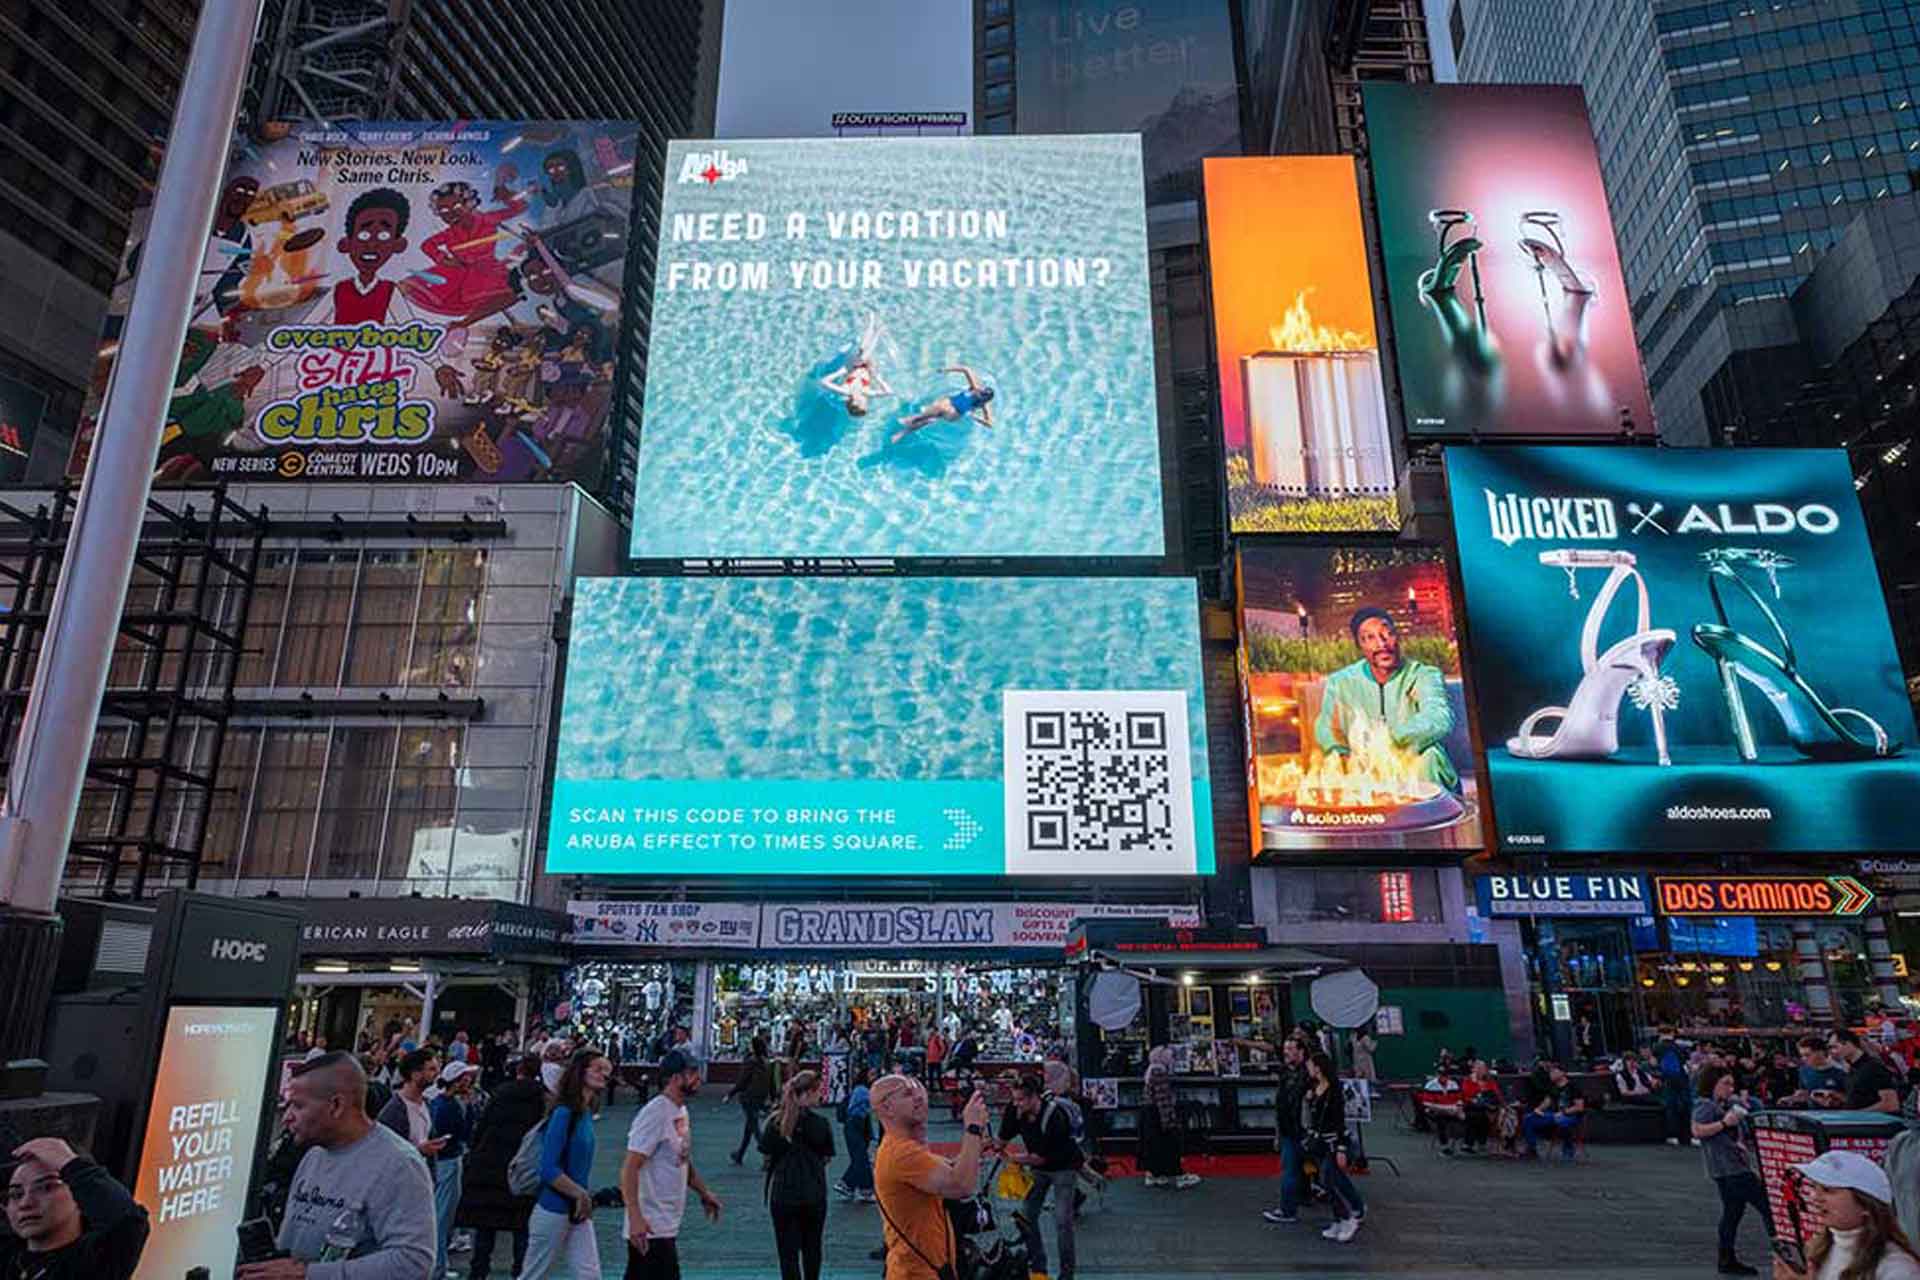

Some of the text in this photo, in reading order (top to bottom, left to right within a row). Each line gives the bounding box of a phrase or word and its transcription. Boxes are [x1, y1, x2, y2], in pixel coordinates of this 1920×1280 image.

[297, 150, 482, 167] New Stories. New Look.
[338, 168, 434, 184] Same Chris.
[672, 209, 1008, 241] NEED A VACATION
[667, 257, 1111, 291] FROM YOUR VACATION?
[272, 323, 444, 351] everybody
[322, 379, 398, 406] hates
[260, 394, 432, 440] chris
[211, 452, 459, 477] NEW SERIES WEDS 10PM
[307, 452, 358, 464] COMEDY
[305, 464, 356, 477] CENTRAL
[1484, 488, 1840, 546] WICKED ALDO
[569, 808, 896, 824] SCAN THIS CODE TO BRING THE
[1306, 813, 1385, 825] solo stove
[1666, 806, 1771, 820] aldoshoes.com
[566, 833, 924, 850] ARUBA EFFECT TO TIMES SQUARE.
[1490, 876, 1641, 899] BLUE FIN
[1663, 882, 1833, 910] DOS CAMINOS
[598, 903, 701, 917] SPORTS FAN SHOP
[1015, 907, 1075, 918] DISCOUNT
[303, 926, 368, 940] ERICAN
[378, 926, 431, 940] EAGLE
[1012, 931, 1063, 942] SOUVEN
[1023, 920, 1055, 930] GIFTS
[211, 939, 267, 962] HOPE
[752, 970, 858, 993] GRAND
[168, 1100, 241, 1132] REFILL
[172, 1128, 232, 1160] YOUR
[158, 1155, 233, 1193] WATER
[159, 1184, 223, 1222] HERE
